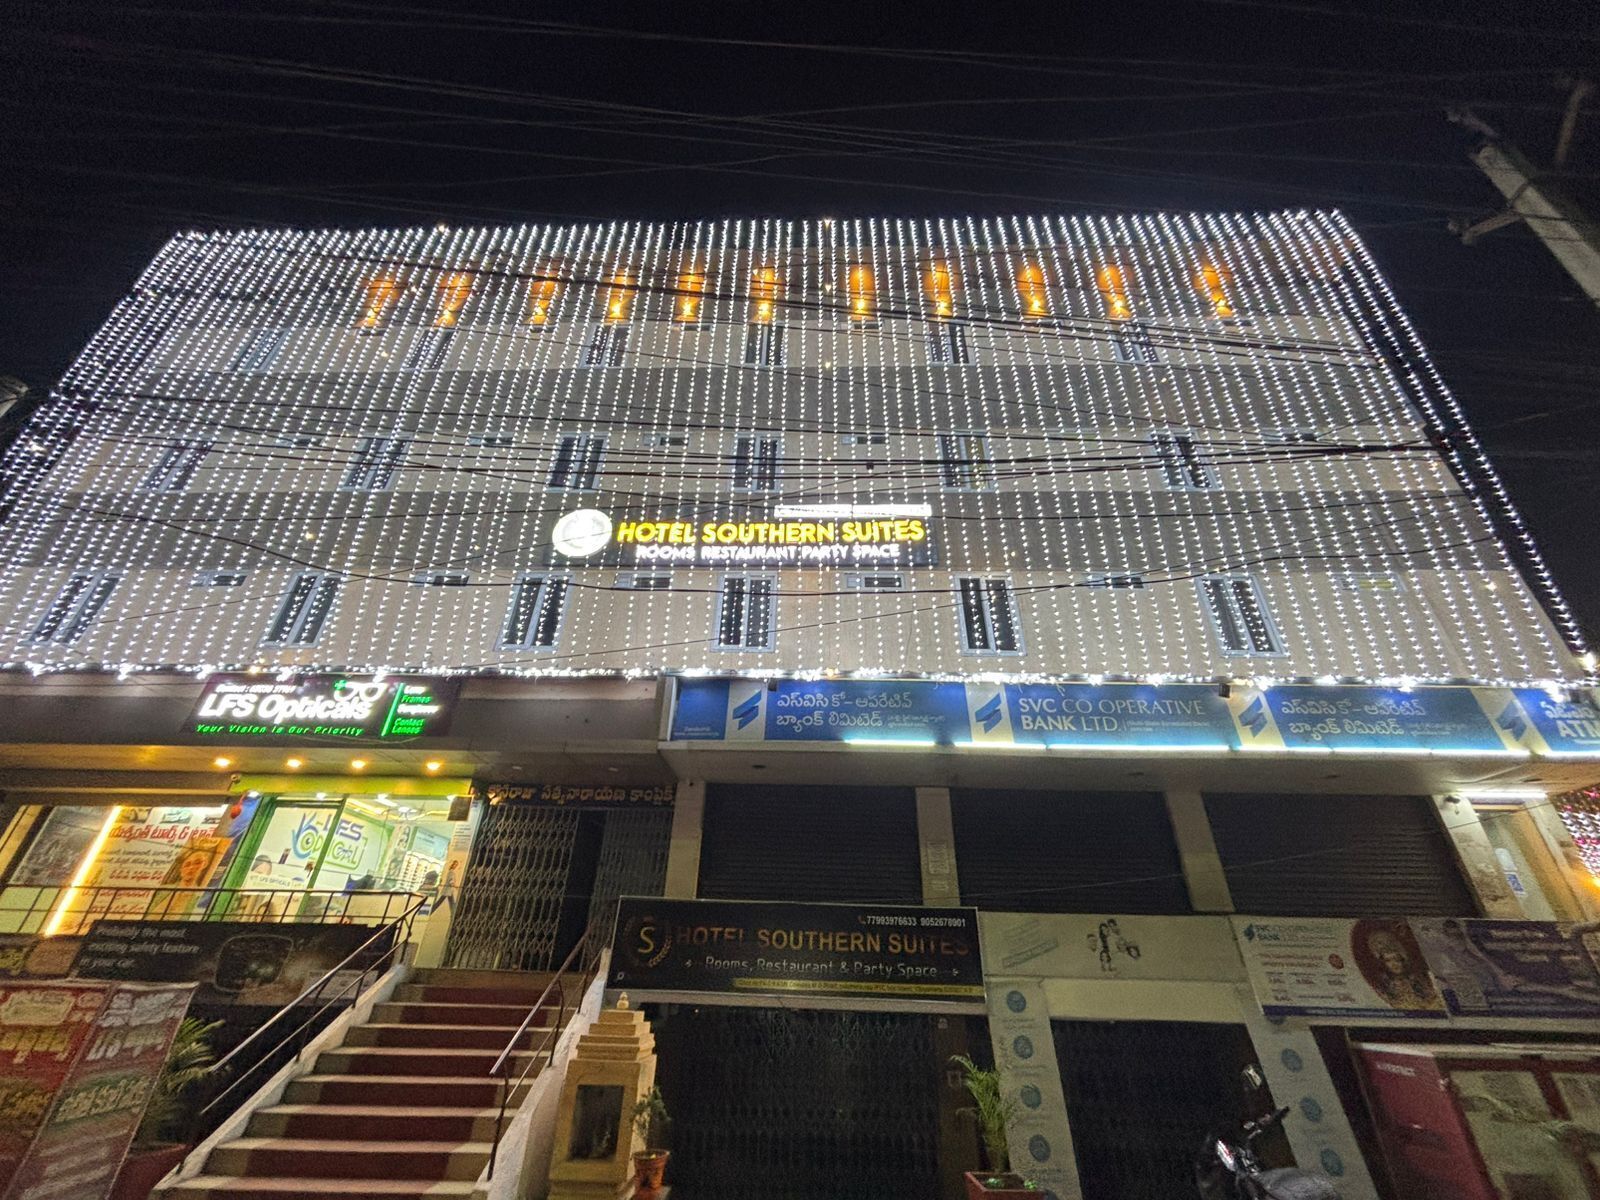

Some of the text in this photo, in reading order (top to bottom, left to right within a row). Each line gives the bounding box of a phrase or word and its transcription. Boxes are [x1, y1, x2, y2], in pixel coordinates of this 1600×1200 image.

[617, 520, 924, 543] HOTEL SOUTHERN SUITES
[636, 543, 900, 560] ROOMS RESTAURANT PARTY SPACE
[198, 693, 257, 717] LFS
[258, 693, 374, 724] Opticals
[1018, 698, 1206, 715] SVC CO OPERATIVE
[196, 724, 223, 732] Your
[228, 724, 266, 733] Vision
[288, 725, 309, 734] Our
[314, 726, 363, 736] Priority
[1021, 715, 1077, 731] BANK
[1081, 716, 1121, 732] LTD.
[757, 928, 880, 952] SOUTHERN
[704, 955, 938, 979] Rooms, Restaurant & Party Space
